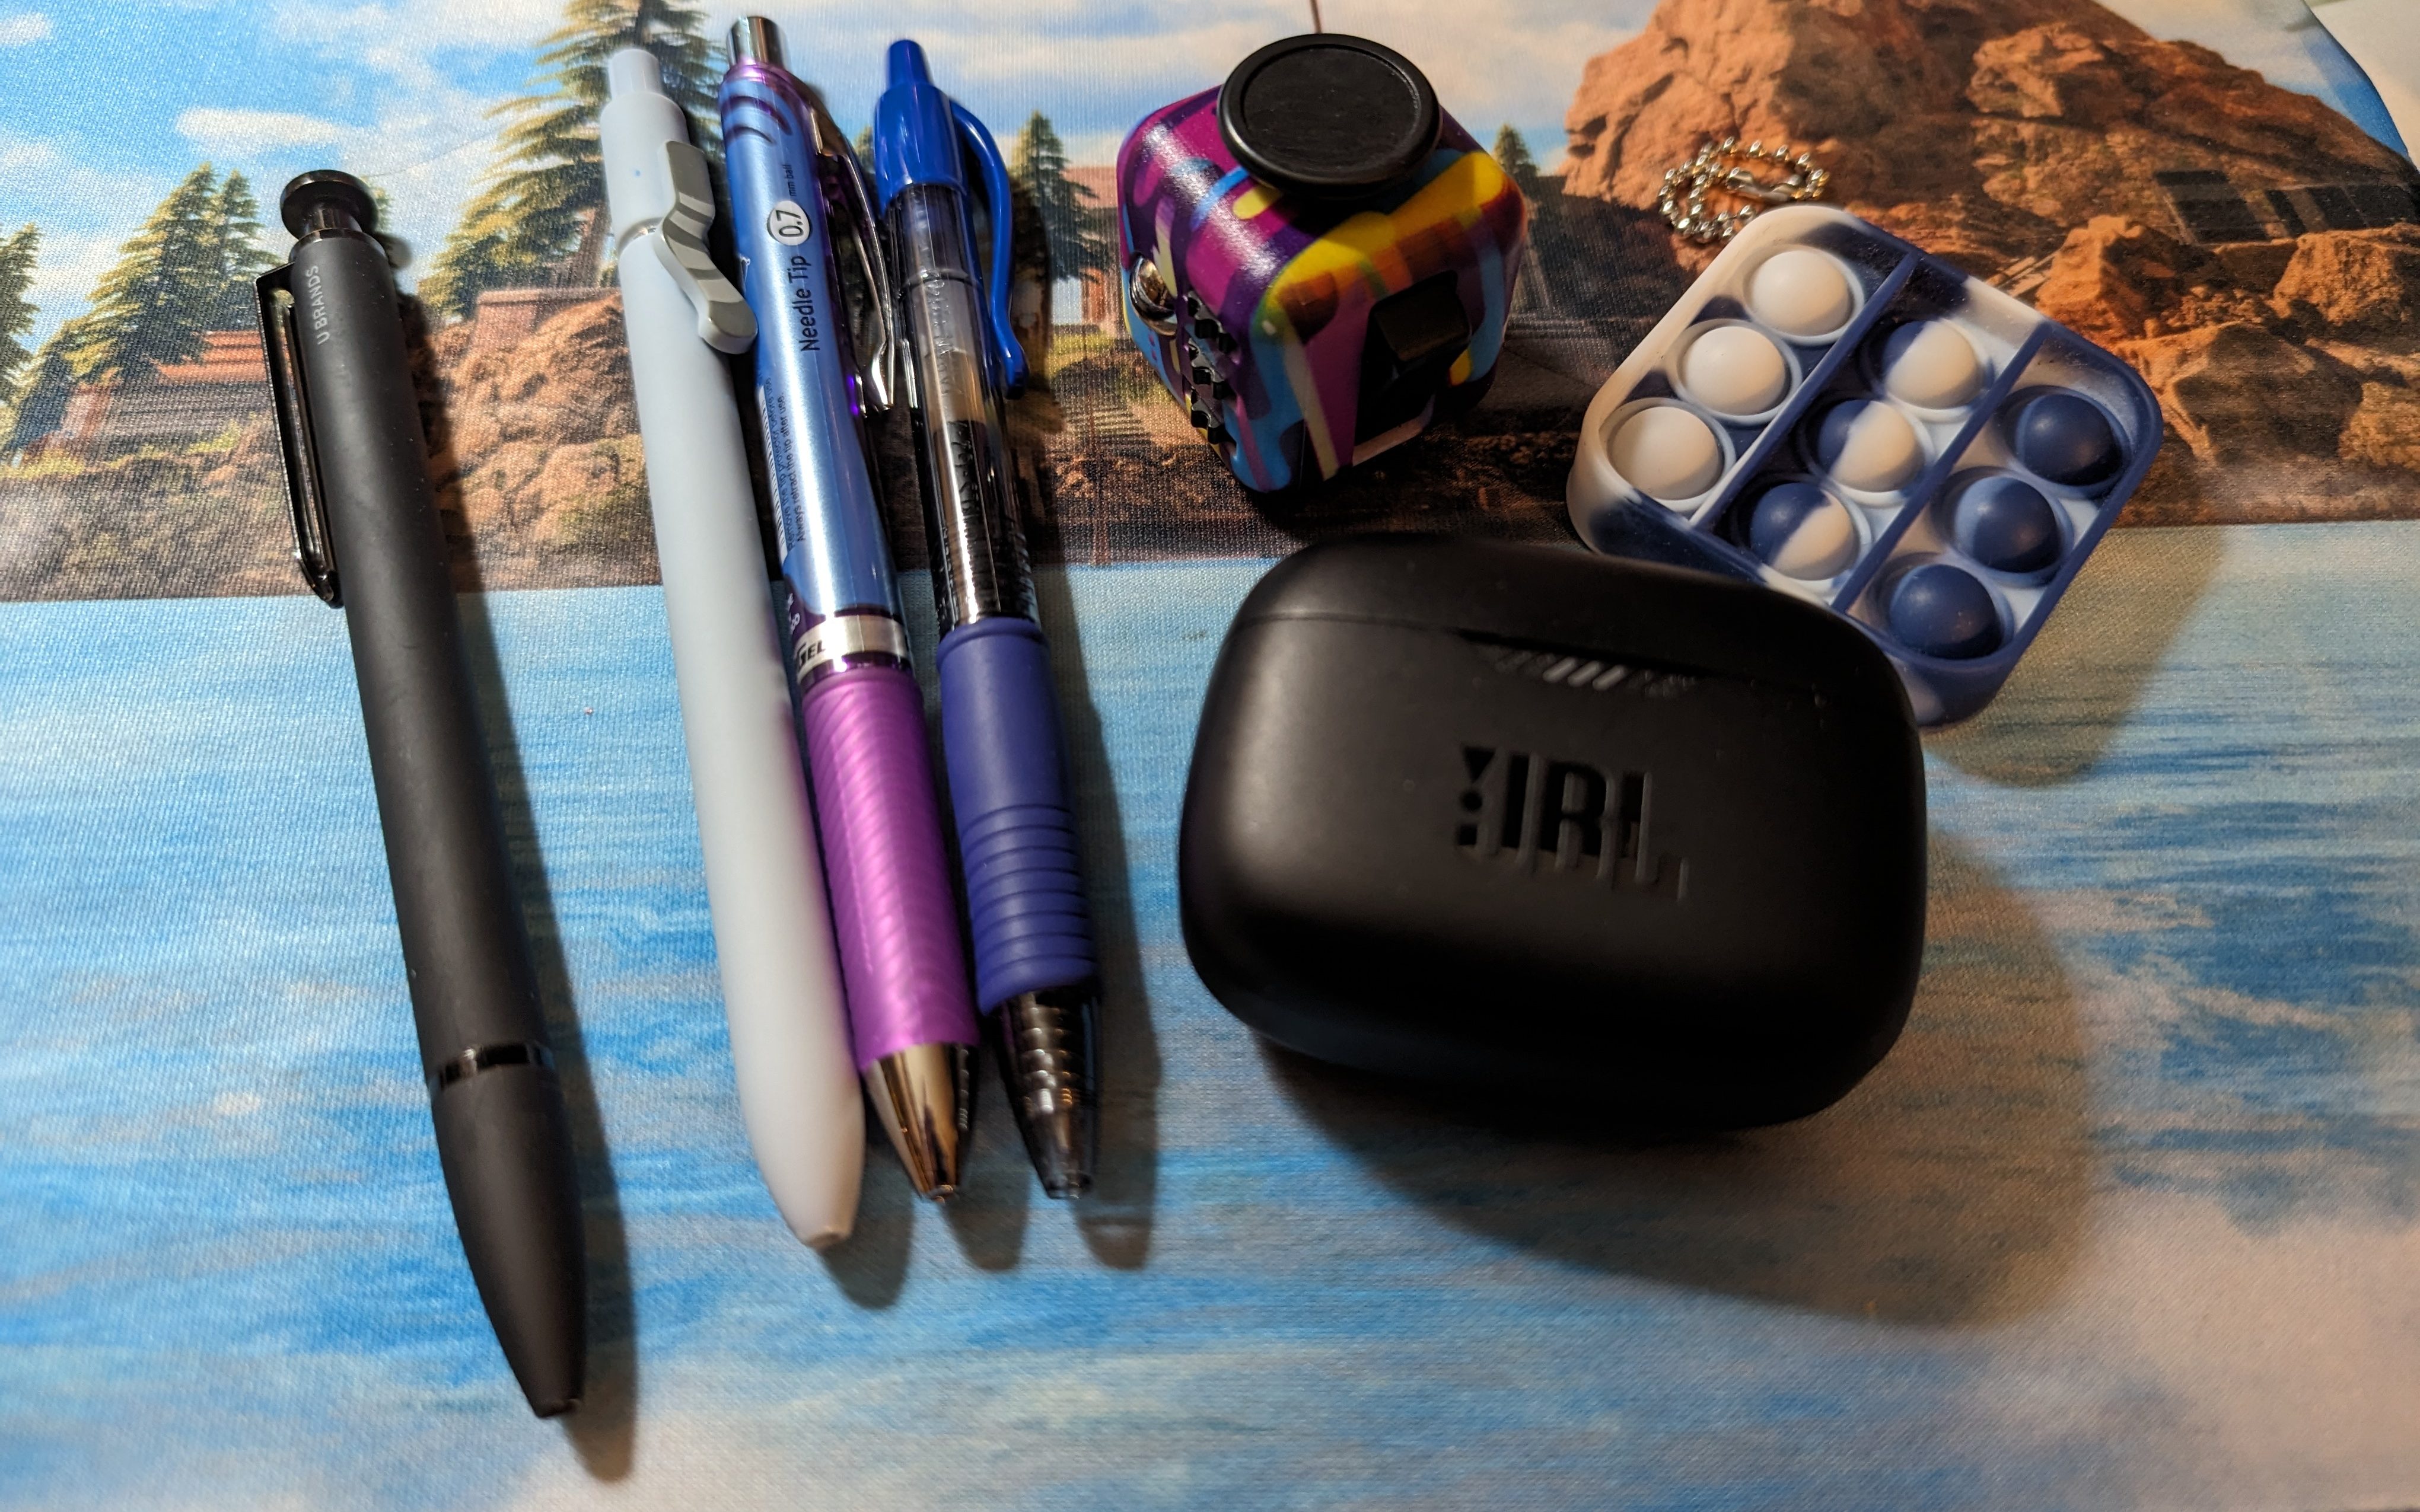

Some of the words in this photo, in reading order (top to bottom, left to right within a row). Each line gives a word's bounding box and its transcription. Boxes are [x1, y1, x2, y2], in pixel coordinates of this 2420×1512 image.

[782, 164, 797, 180] ball
[787, 181, 797, 197] mm
[775, 209, 804, 238] 0.7
[789, 255, 811, 284] Tip
[305, 265, 329, 330] BRANDS
[792, 288, 821, 352] Needle
[317, 331, 329, 346] U
[781, 416, 790, 438] after
[783, 439, 793, 454] tip
[786, 453, 795, 470] the
[781, 488, 789, 506] the
[788, 471, 800, 504] retract
[785, 507, 795, 551] Remove
[794, 505, 805, 542] Always
